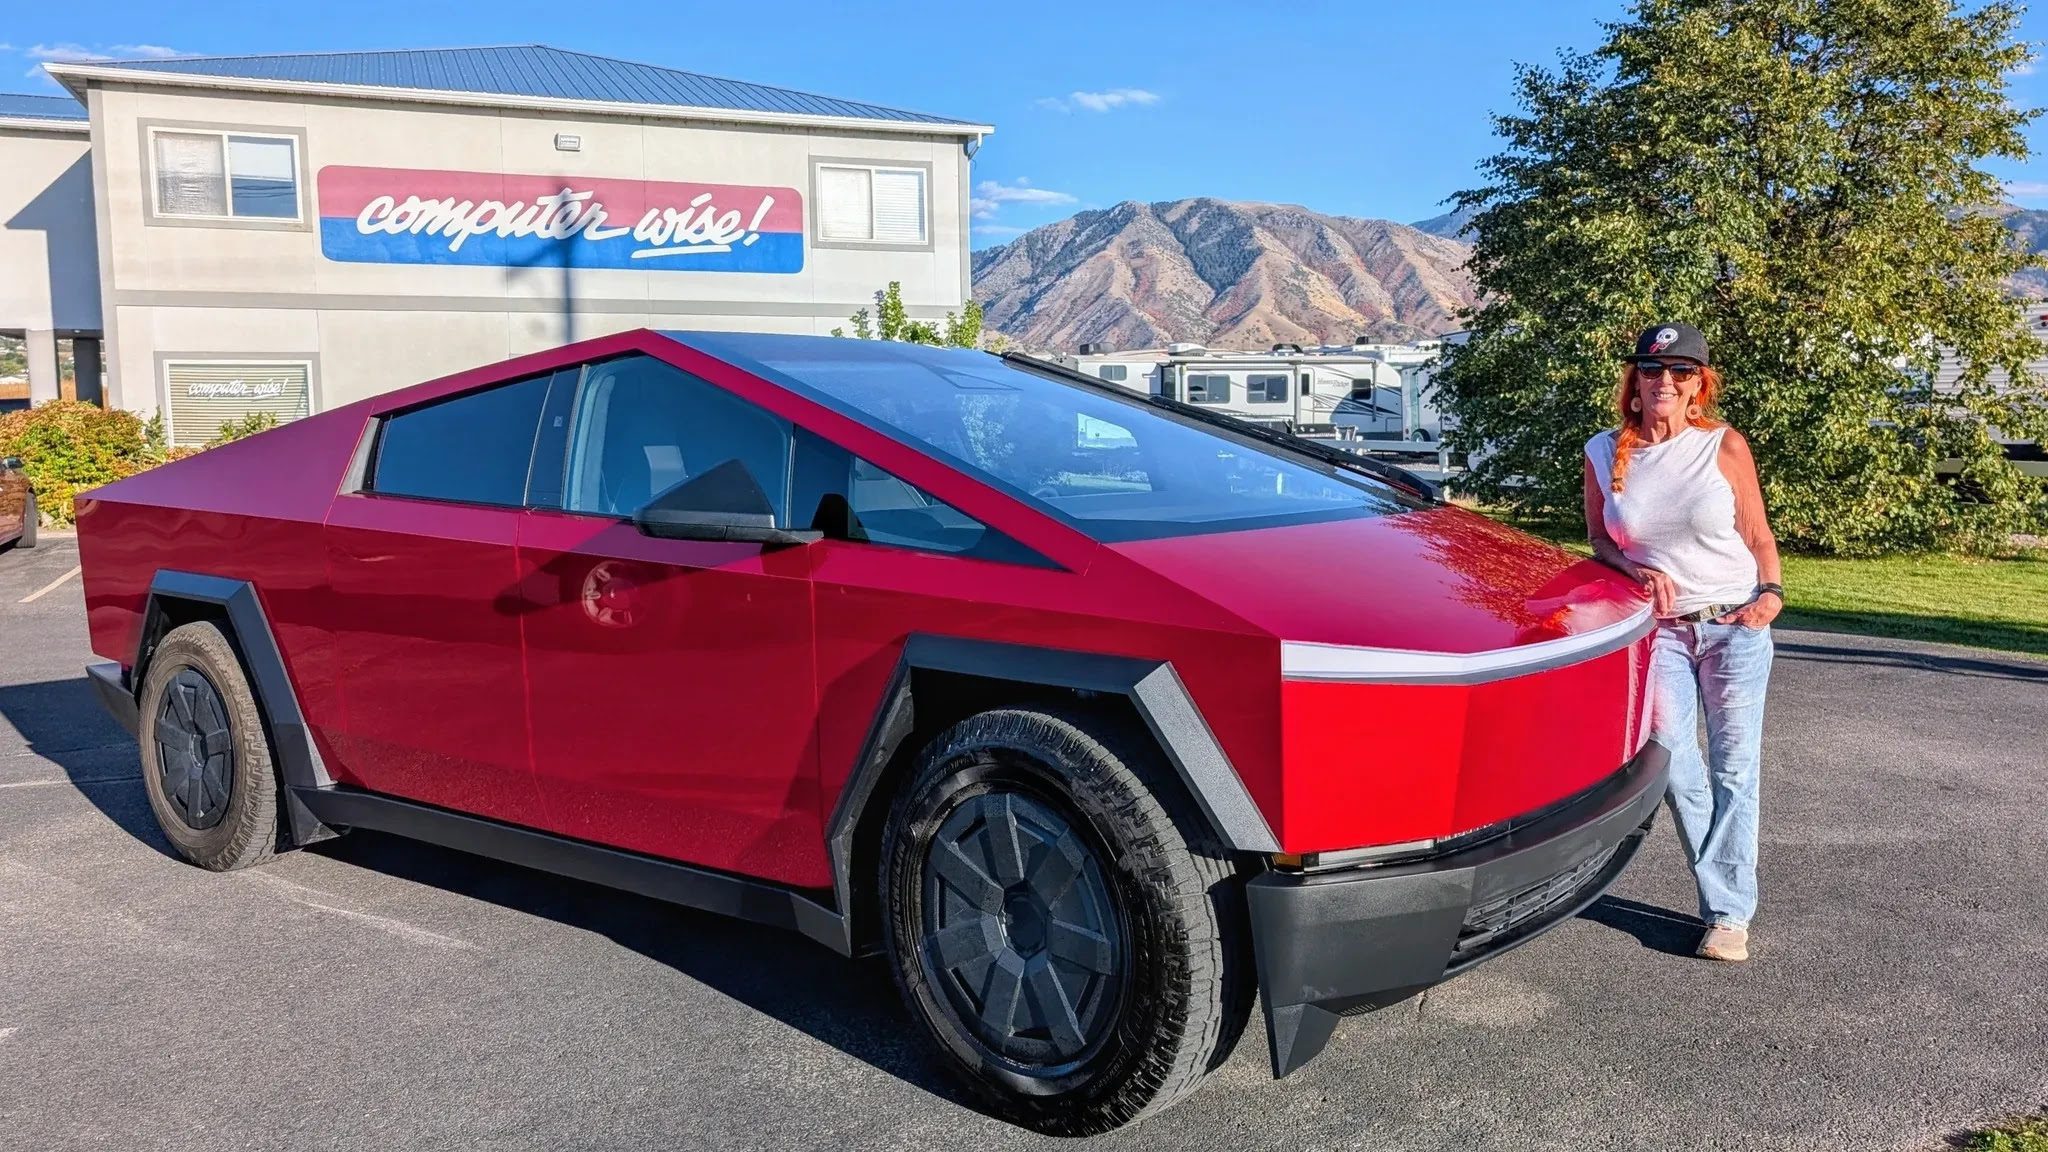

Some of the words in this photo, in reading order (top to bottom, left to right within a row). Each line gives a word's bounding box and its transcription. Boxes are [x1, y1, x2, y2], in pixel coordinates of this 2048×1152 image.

[357, 188, 629, 251] computer
[631, 193, 775, 258] wise!
[188, 379, 251, 398] computer
[252, 377, 289, 399] wise!
